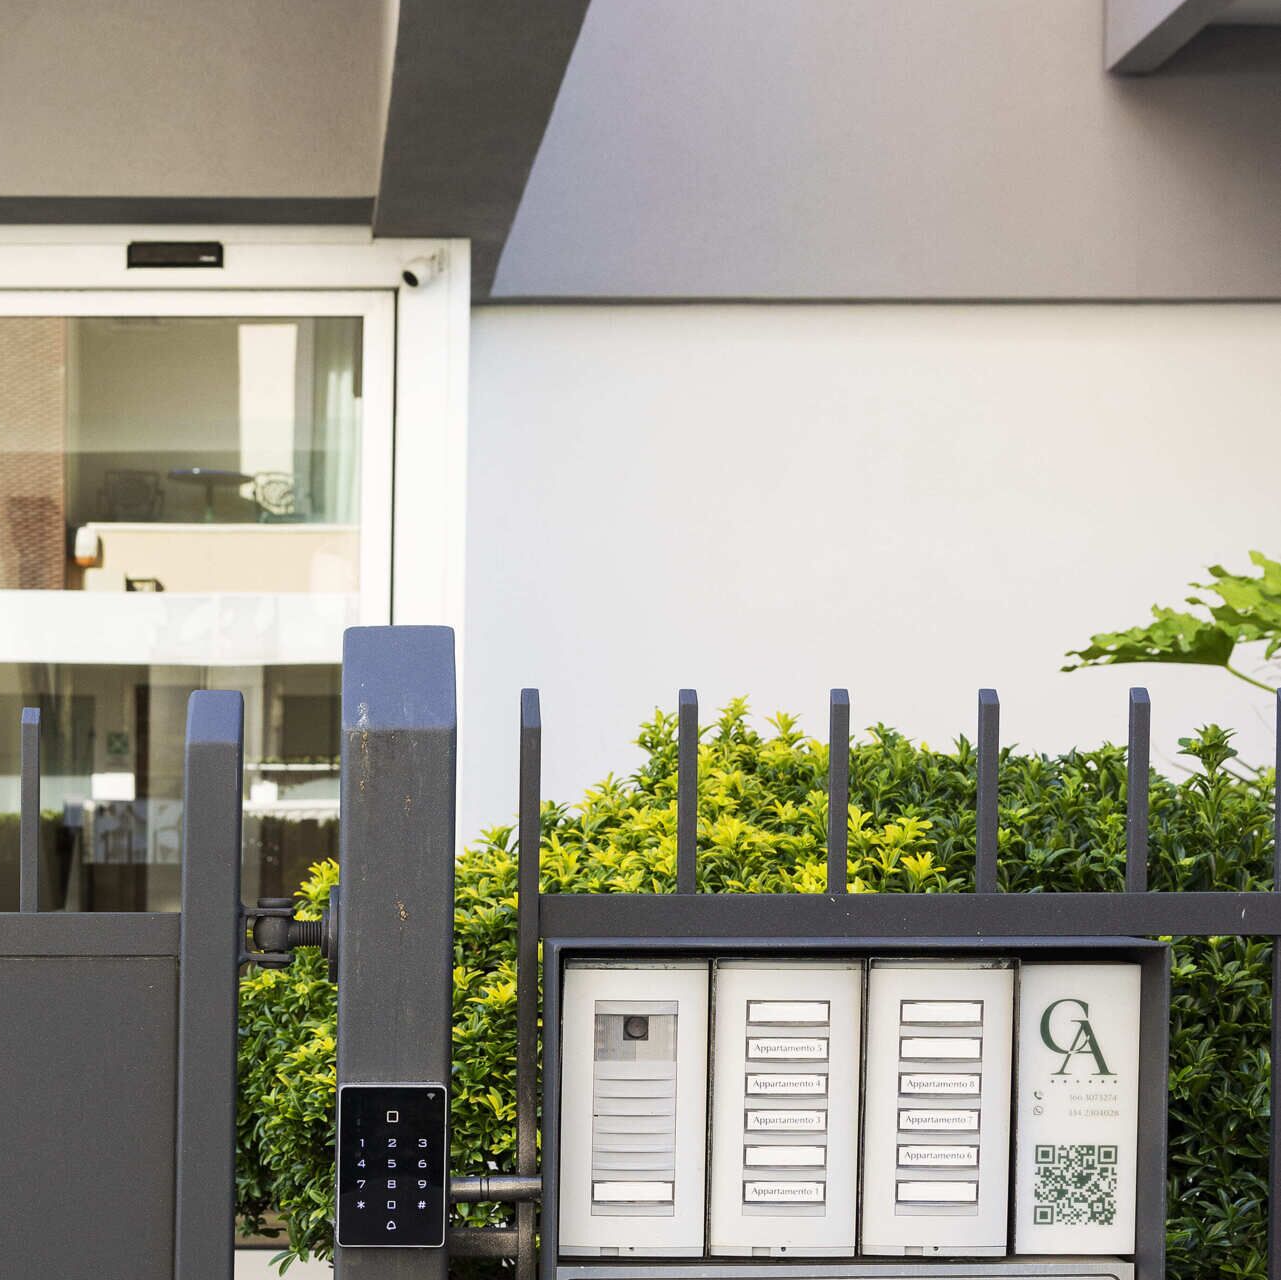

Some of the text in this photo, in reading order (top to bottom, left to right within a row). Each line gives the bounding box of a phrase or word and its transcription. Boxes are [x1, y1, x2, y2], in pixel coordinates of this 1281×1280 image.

[755, 1044, 815, 1053] Appartamento
[752, 1080, 813, 1089] Appartamento
[907, 1080, 967, 1089] Appartamento
[753, 1116, 813, 1125] Appartamento
[905, 1116, 966, 1125] Appartamento
[388, 1139, 396, 1147] 2
[418, 1139, 427, 1147] 3
[904, 1152, 964, 1160] Appartamento
[358, 1160, 426, 1168] 4 5 6
[357, 1180, 426, 1188] 7 8 9
[751, 1188, 812, 1196] Appartamento
